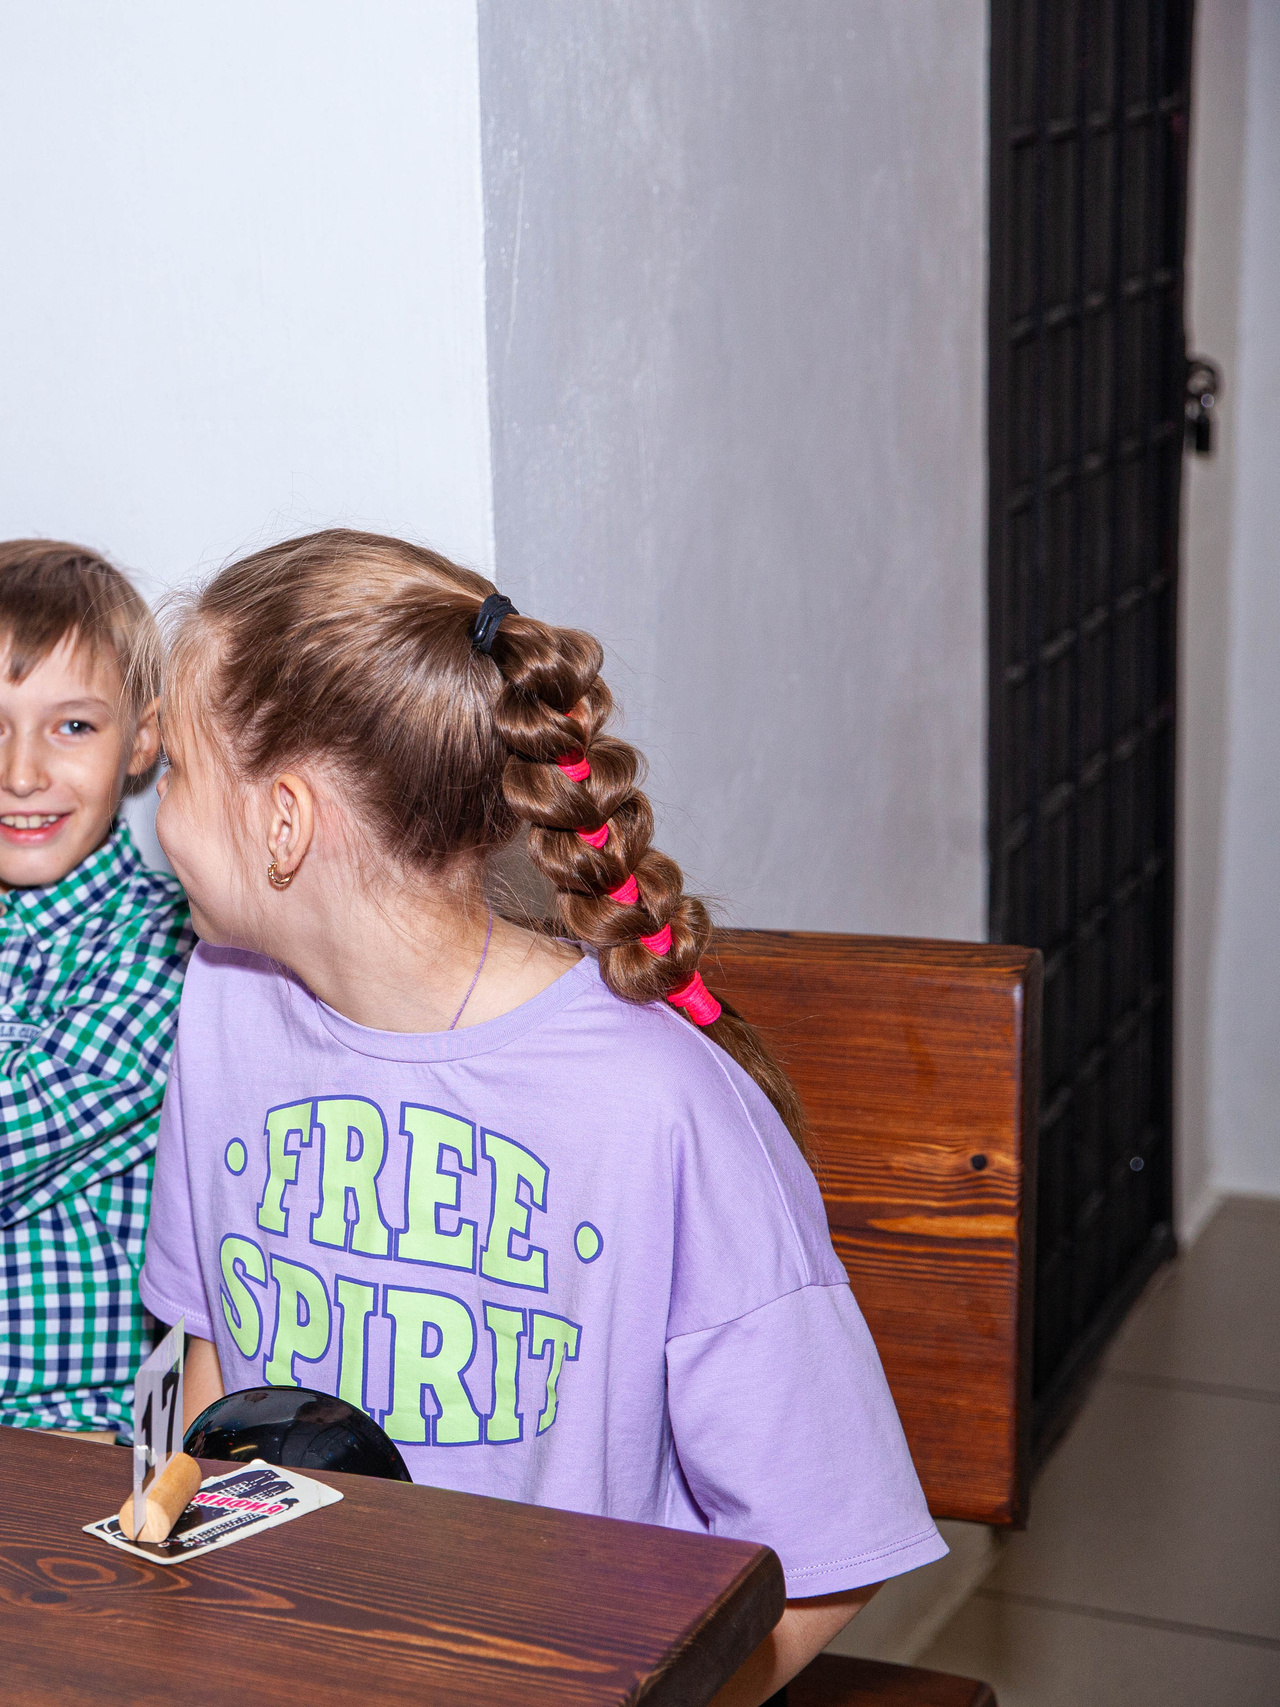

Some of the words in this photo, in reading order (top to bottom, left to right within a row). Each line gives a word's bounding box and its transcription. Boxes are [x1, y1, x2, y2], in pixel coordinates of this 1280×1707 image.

[255, 1094, 550, 1293] FREE
[218, 1232, 583, 1447] SPIRIT
[141, 1357, 180, 1495] 17
[191, 1491, 284, 1516] МАФИЯ
